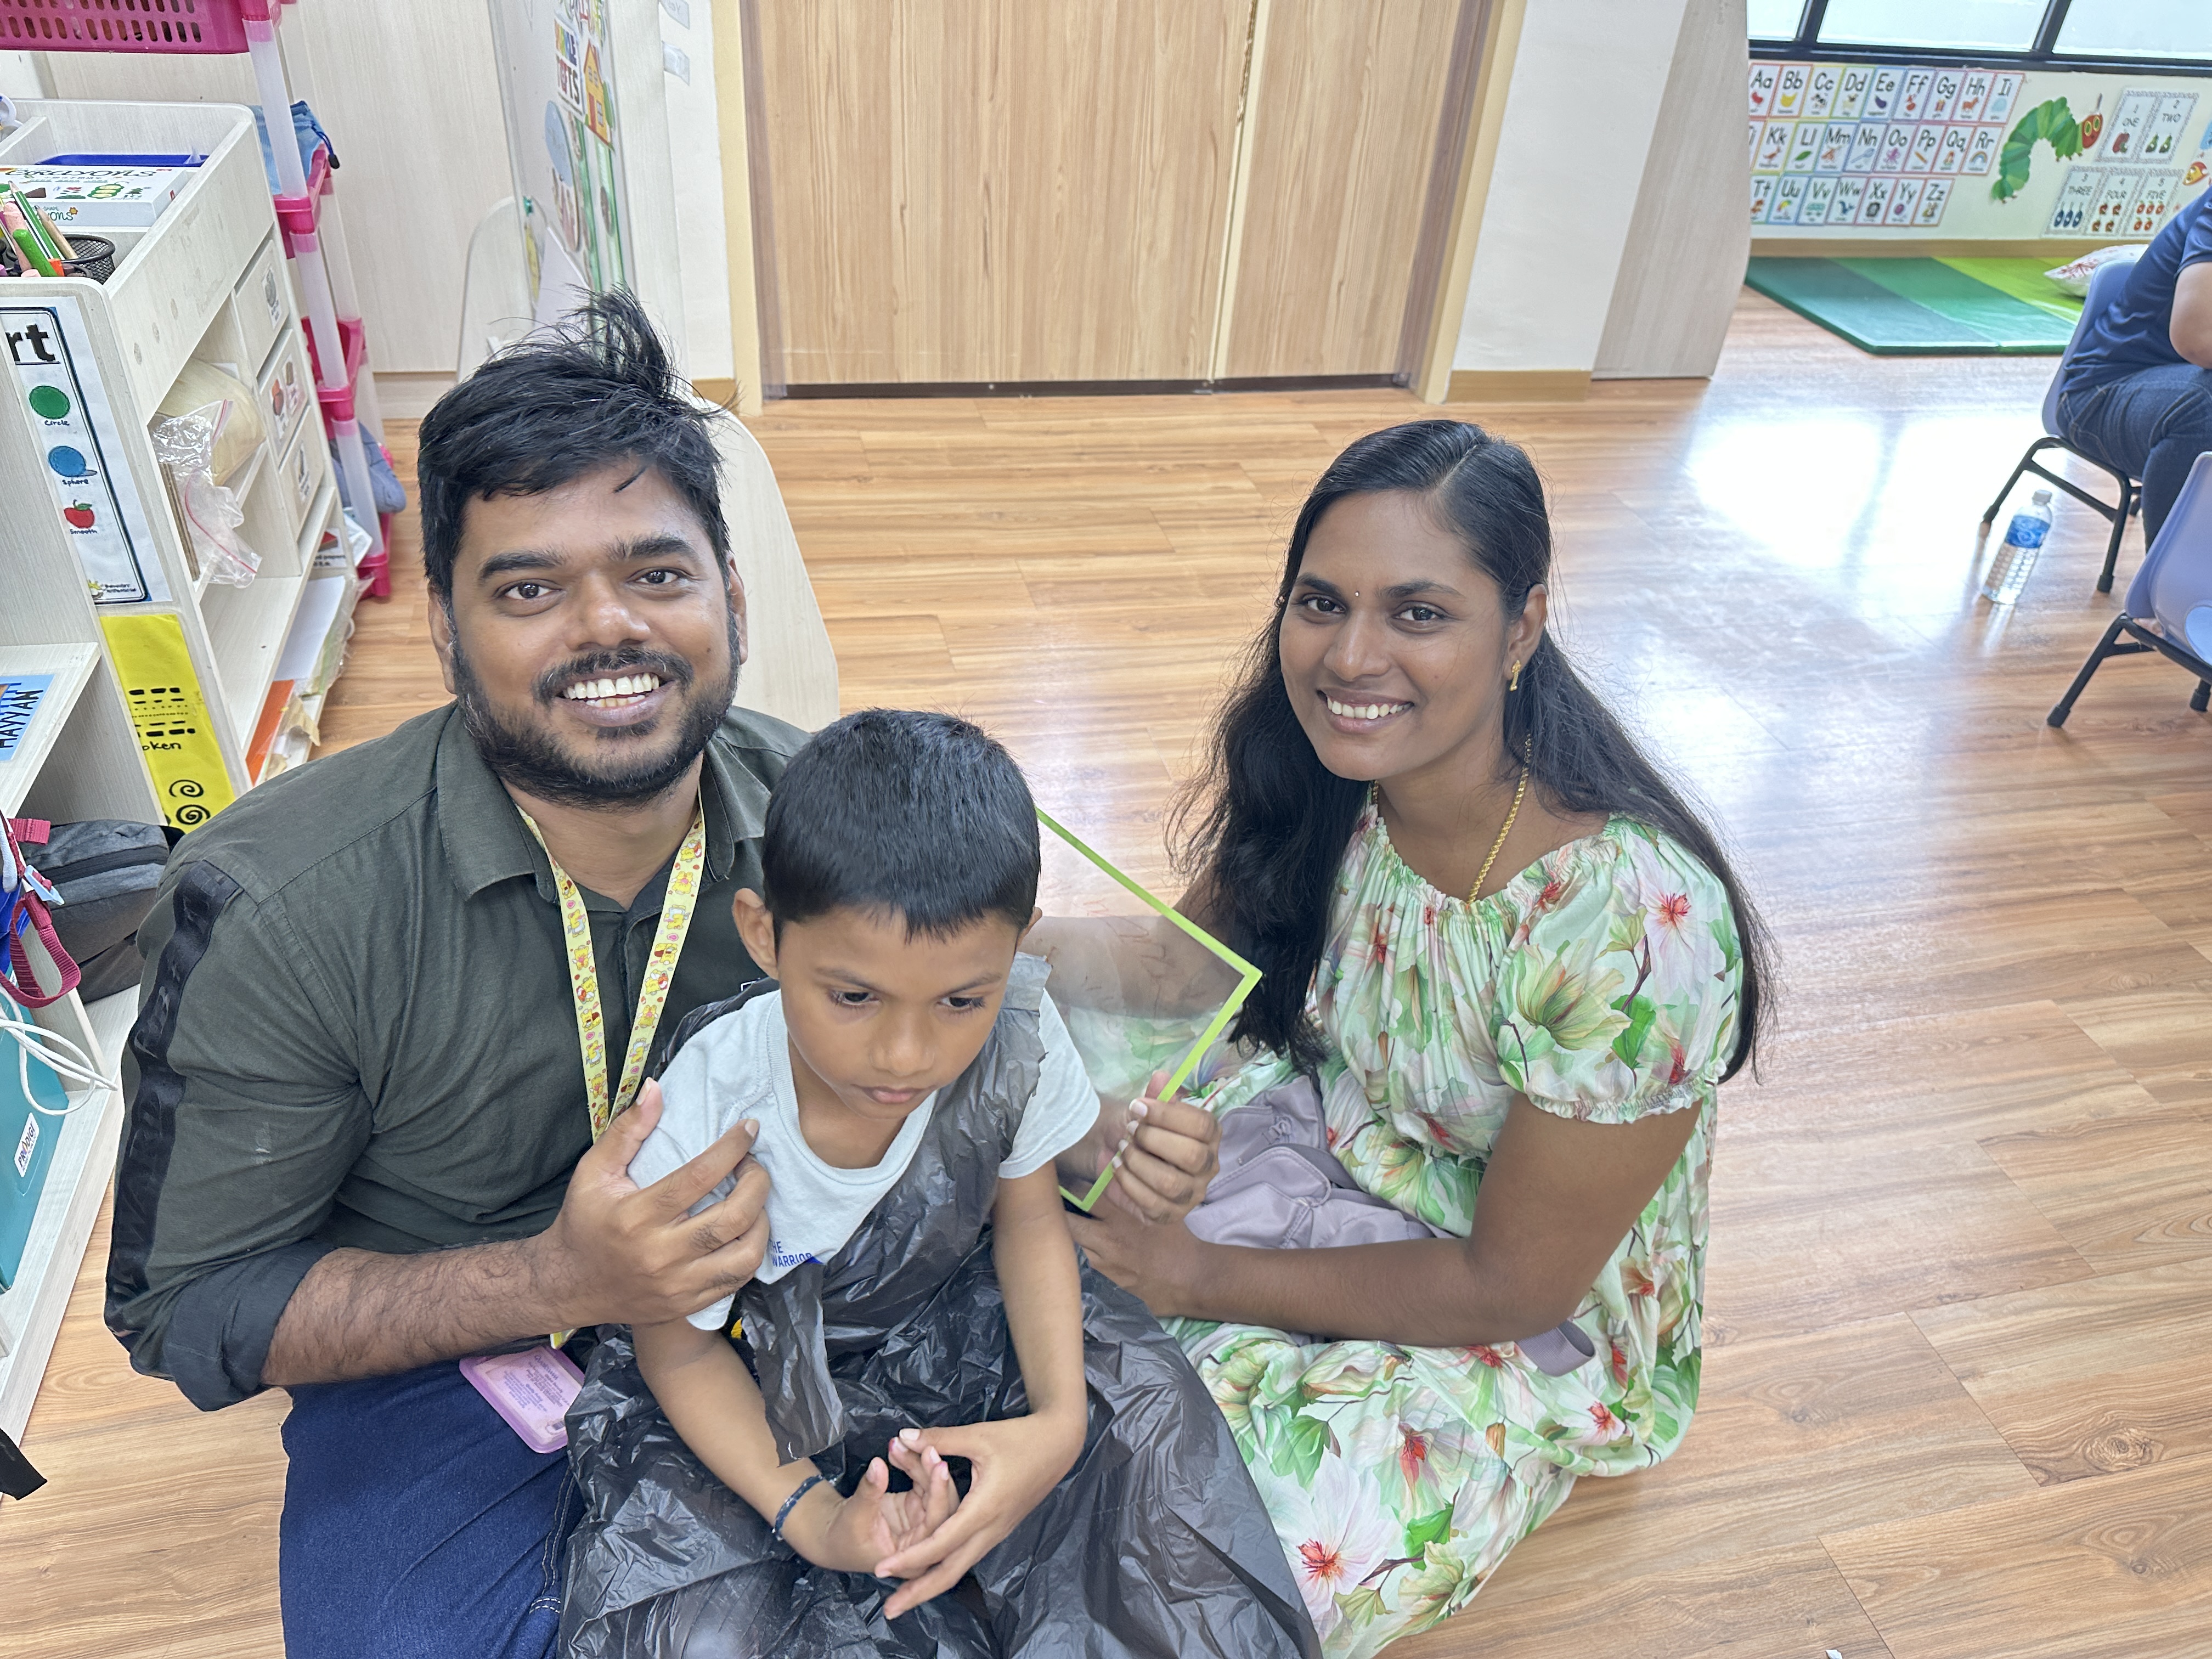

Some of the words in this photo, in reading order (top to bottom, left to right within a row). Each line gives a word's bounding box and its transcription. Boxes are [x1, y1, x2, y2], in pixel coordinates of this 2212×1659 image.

[1750, 70, 1773, 88] Aa
[1783, 70, 1803, 89] Bb
[1814, 72, 1834, 91] Cc
[1844, 72, 1868, 92] Dd
[1875, 73, 1895, 92] Ee
[1906, 75, 1928, 94] Ff
[1937, 76, 1956, 99] Gg
[1966, 77, 1985, 96] Hh
[1997, 78, 2012, 97] Ii
[2173, 99, 2180, 109] 2
[2122, 117, 2140, 127] ONE
[2162, 112, 2181, 123] TWO
[1766, 126, 1787, 145] Kk
[1826, 127, 1850, 144] Mm
[1857, 127, 1878, 146] Nn
[1888, 128, 1908, 147] Oo
[1917, 129, 1937, 152] Pp
[1946, 130, 1966, 153] Qq
[1975, 131, 1994, 149] Rr
[1753, 179, 1771, 198] Tt
[1781, 179, 1801, 198] Uu
[1813, 182, 1831, 199] Vv
[1839, 181, 1861, 196] Ww
[1869, 182, 1888, 200] Xx
[1899, 182, 1917, 205] Yy
[1926, 183, 1945, 201] Zz
[2068, 185, 2092, 196] THREE
[2104, 189, 2127, 200] FOUR
[2146, 190, 2166, 200] FIVE
